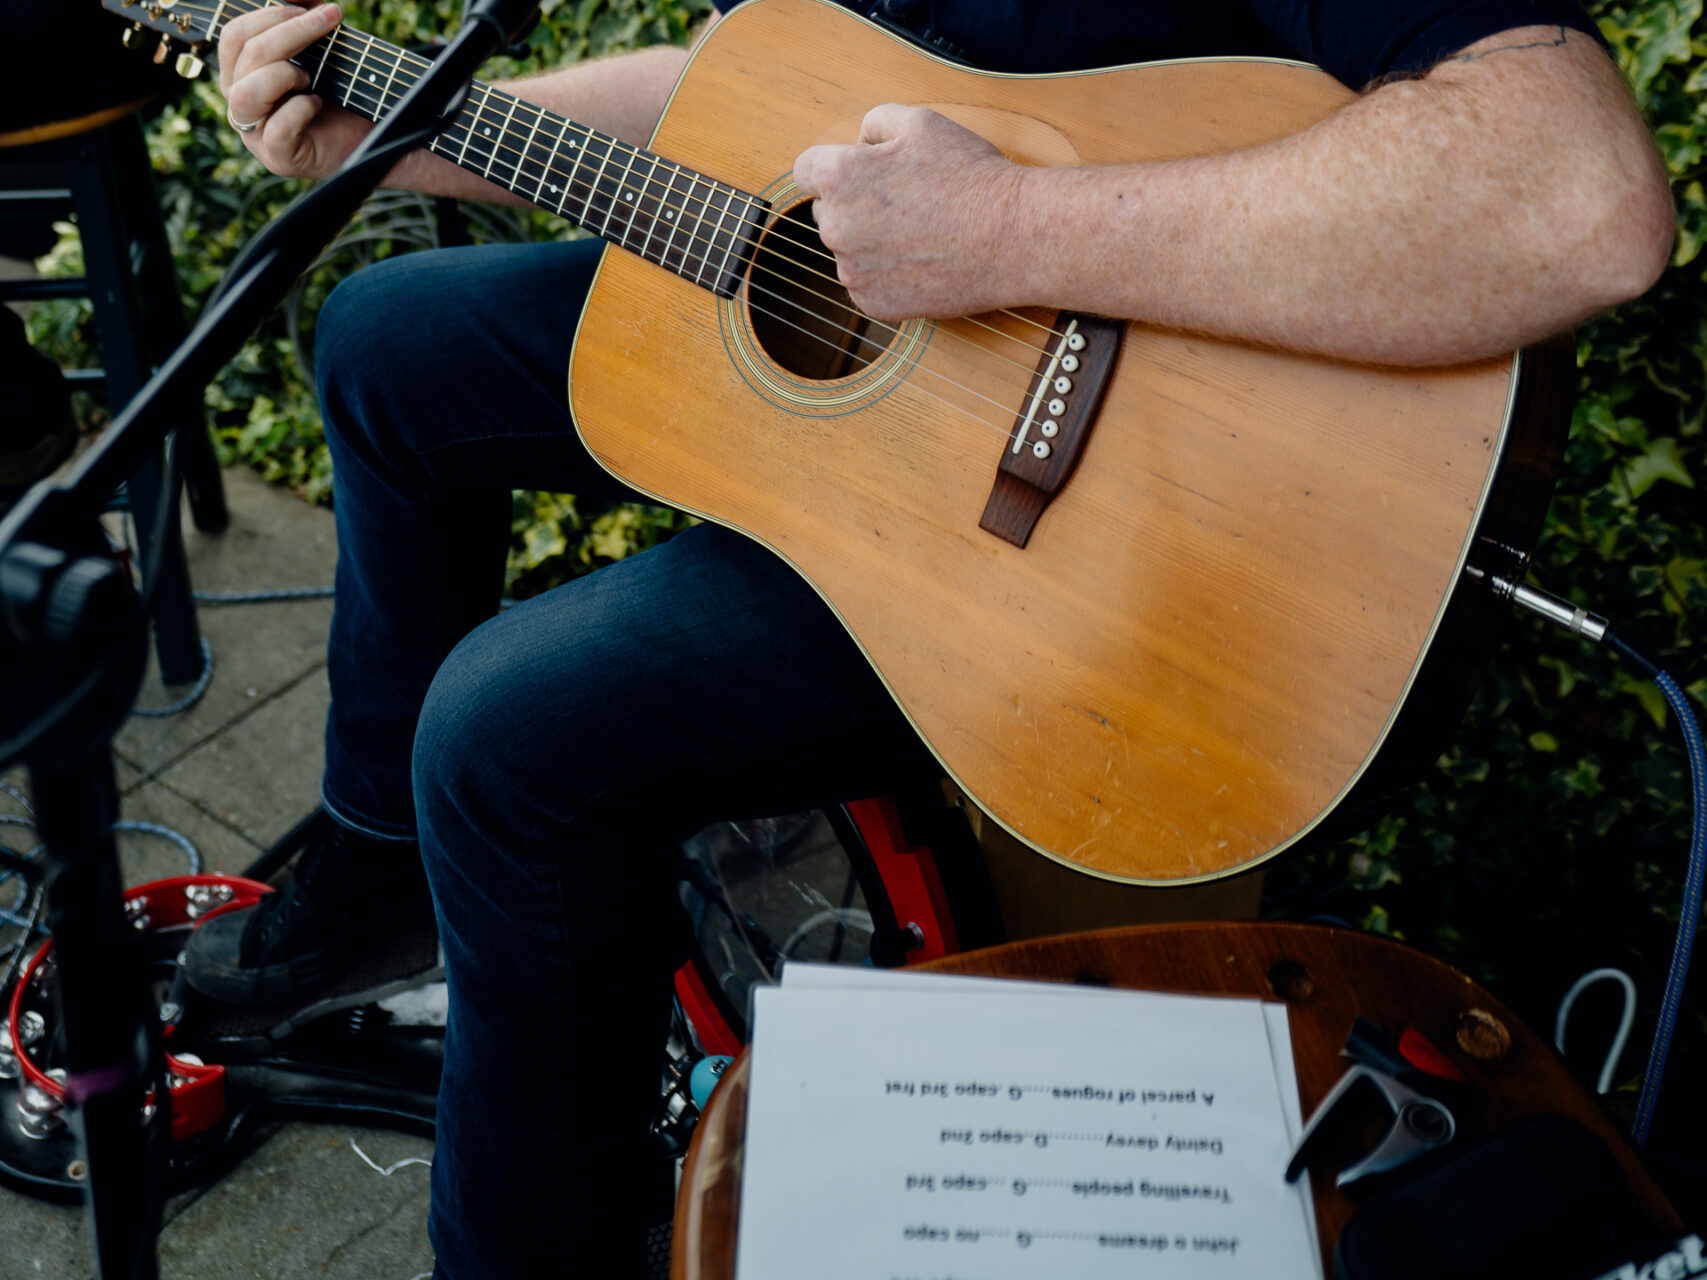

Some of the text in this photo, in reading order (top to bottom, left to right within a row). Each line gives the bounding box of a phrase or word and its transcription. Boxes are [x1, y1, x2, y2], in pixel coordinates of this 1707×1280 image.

[885, 1081, 915, 1097] fret
[920, 1081, 949, 1098] 3rd
[1118, 1088, 1136, 1104] of
[1142, 1086, 1196, 1105] parcel
[939, 1128, 973, 1146] 2nd
[1165, 1132, 1223, 1155] Dainty
[905, 1174, 937, 1193] 3rd
[1140, 1179, 1231, 1204] Travelling
[903, 1223, 950, 1242] capo
[1192, 1235, 1239, 1256] John
